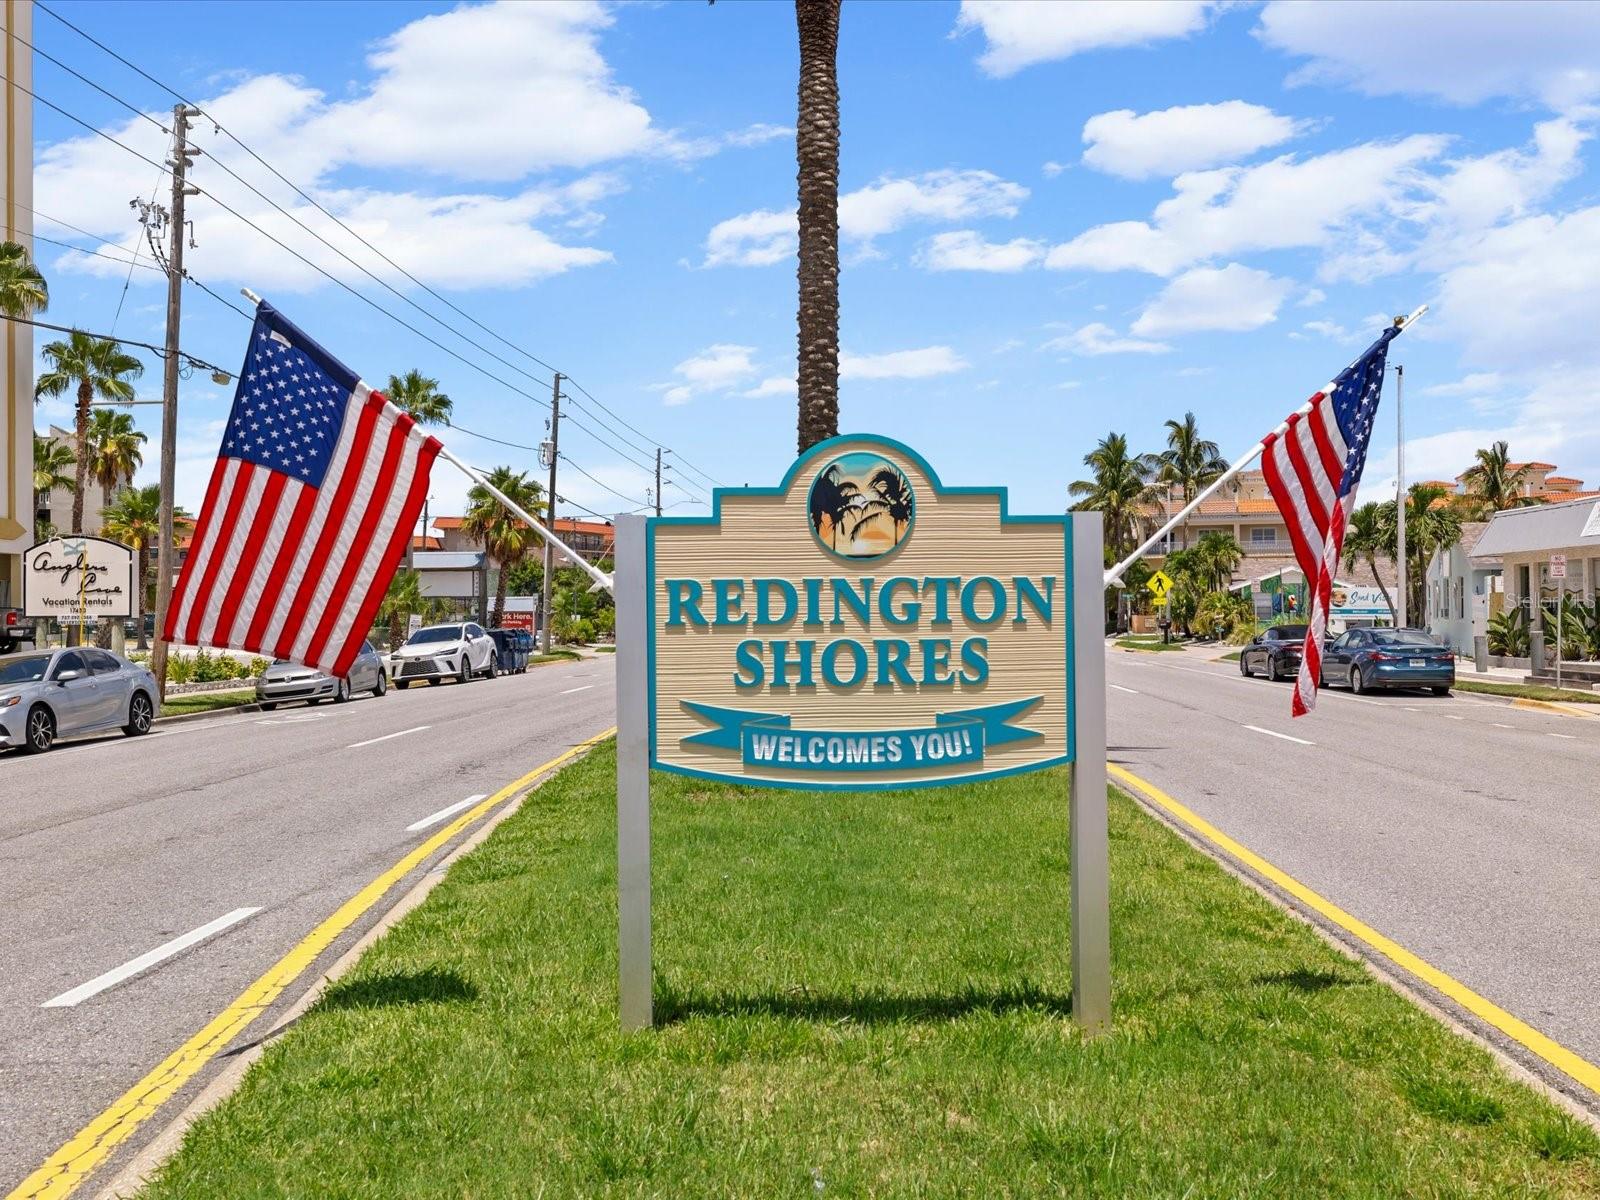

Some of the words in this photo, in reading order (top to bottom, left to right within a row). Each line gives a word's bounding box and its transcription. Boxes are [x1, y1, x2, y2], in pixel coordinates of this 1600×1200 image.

[42, 597, 80, 606] Vacation
[664, 576, 1056, 626] REDINGTON
[733, 637, 990, 688] SHORES
[752, 733, 902, 764] WELCOMES
[910, 729, 973, 760] YOU!
